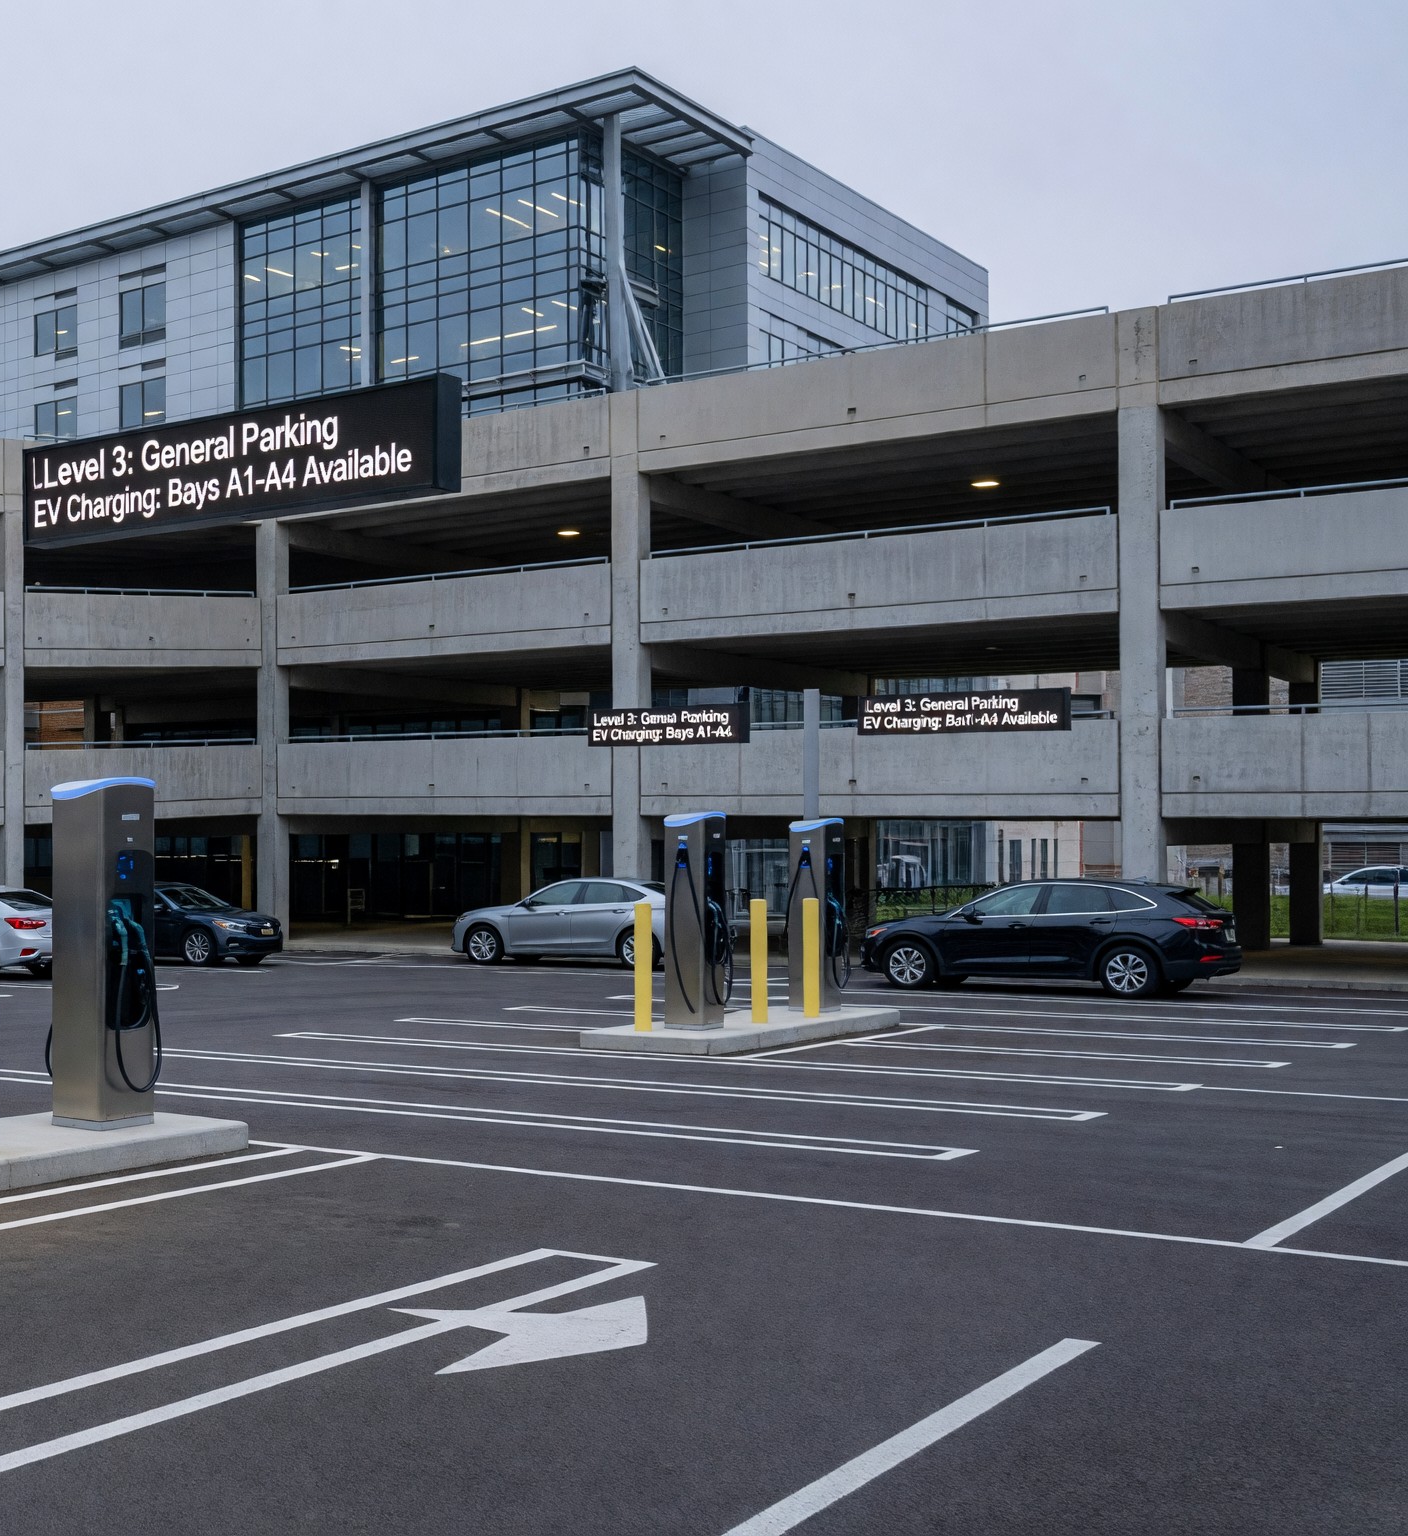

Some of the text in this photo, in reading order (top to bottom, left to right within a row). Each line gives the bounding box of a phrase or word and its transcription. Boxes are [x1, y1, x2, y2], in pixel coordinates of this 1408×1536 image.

[112, 446, 134, 478] 3:
[142, 425, 234, 472] General
[242, 414, 339, 456] Parking
[34, 443, 412, 528] EV Charging: Bays A1-A4 Available
[920, 697, 969, 712] General
[972, 695, 1019, 712] Parking
[863, 716, 881, 730] EV
[1002, 710, 1058, 726] Available
[593, 729, 609, 742] EV
